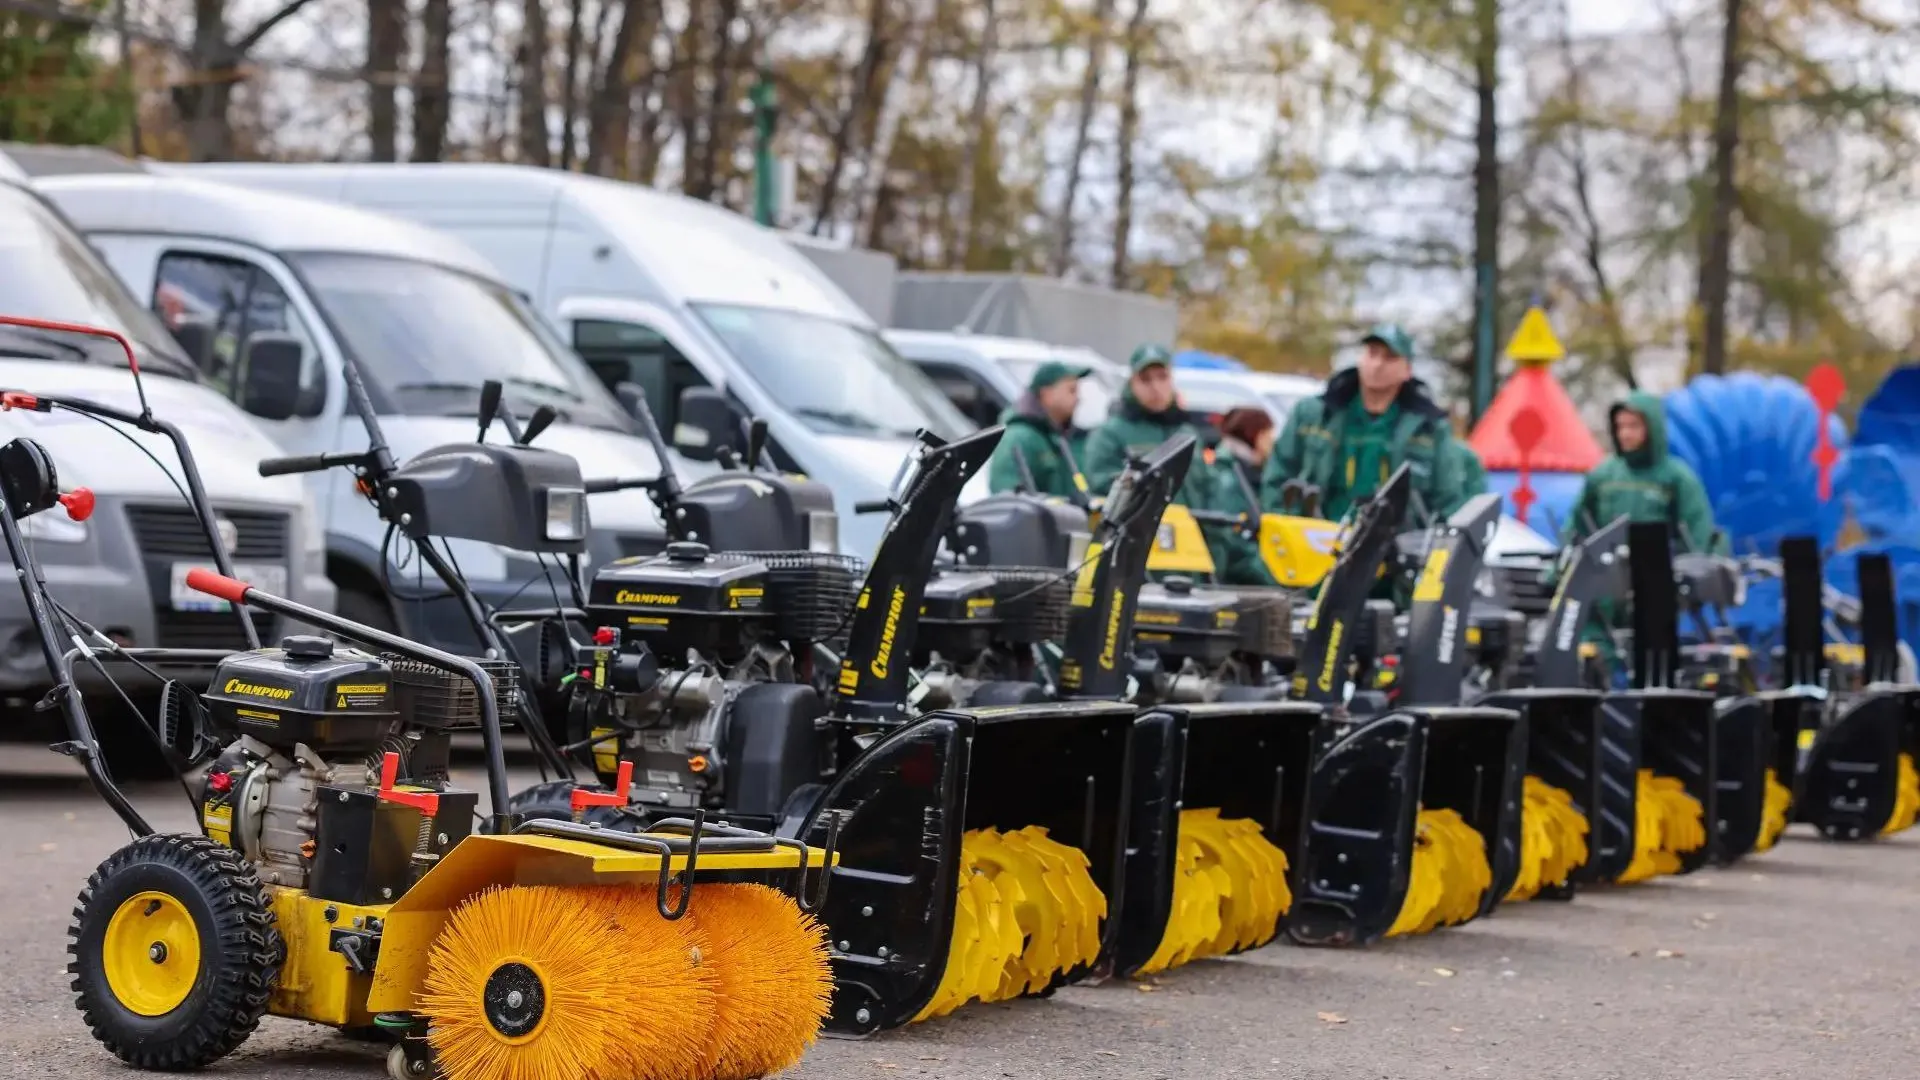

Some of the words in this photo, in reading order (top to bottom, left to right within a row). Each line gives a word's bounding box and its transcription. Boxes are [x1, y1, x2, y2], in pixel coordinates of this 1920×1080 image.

[616, 589, 680, 605] CHAMPION
[870, 584, 905, 679] CHAMPION
[224, 678, 293, 700] CHAMPION
